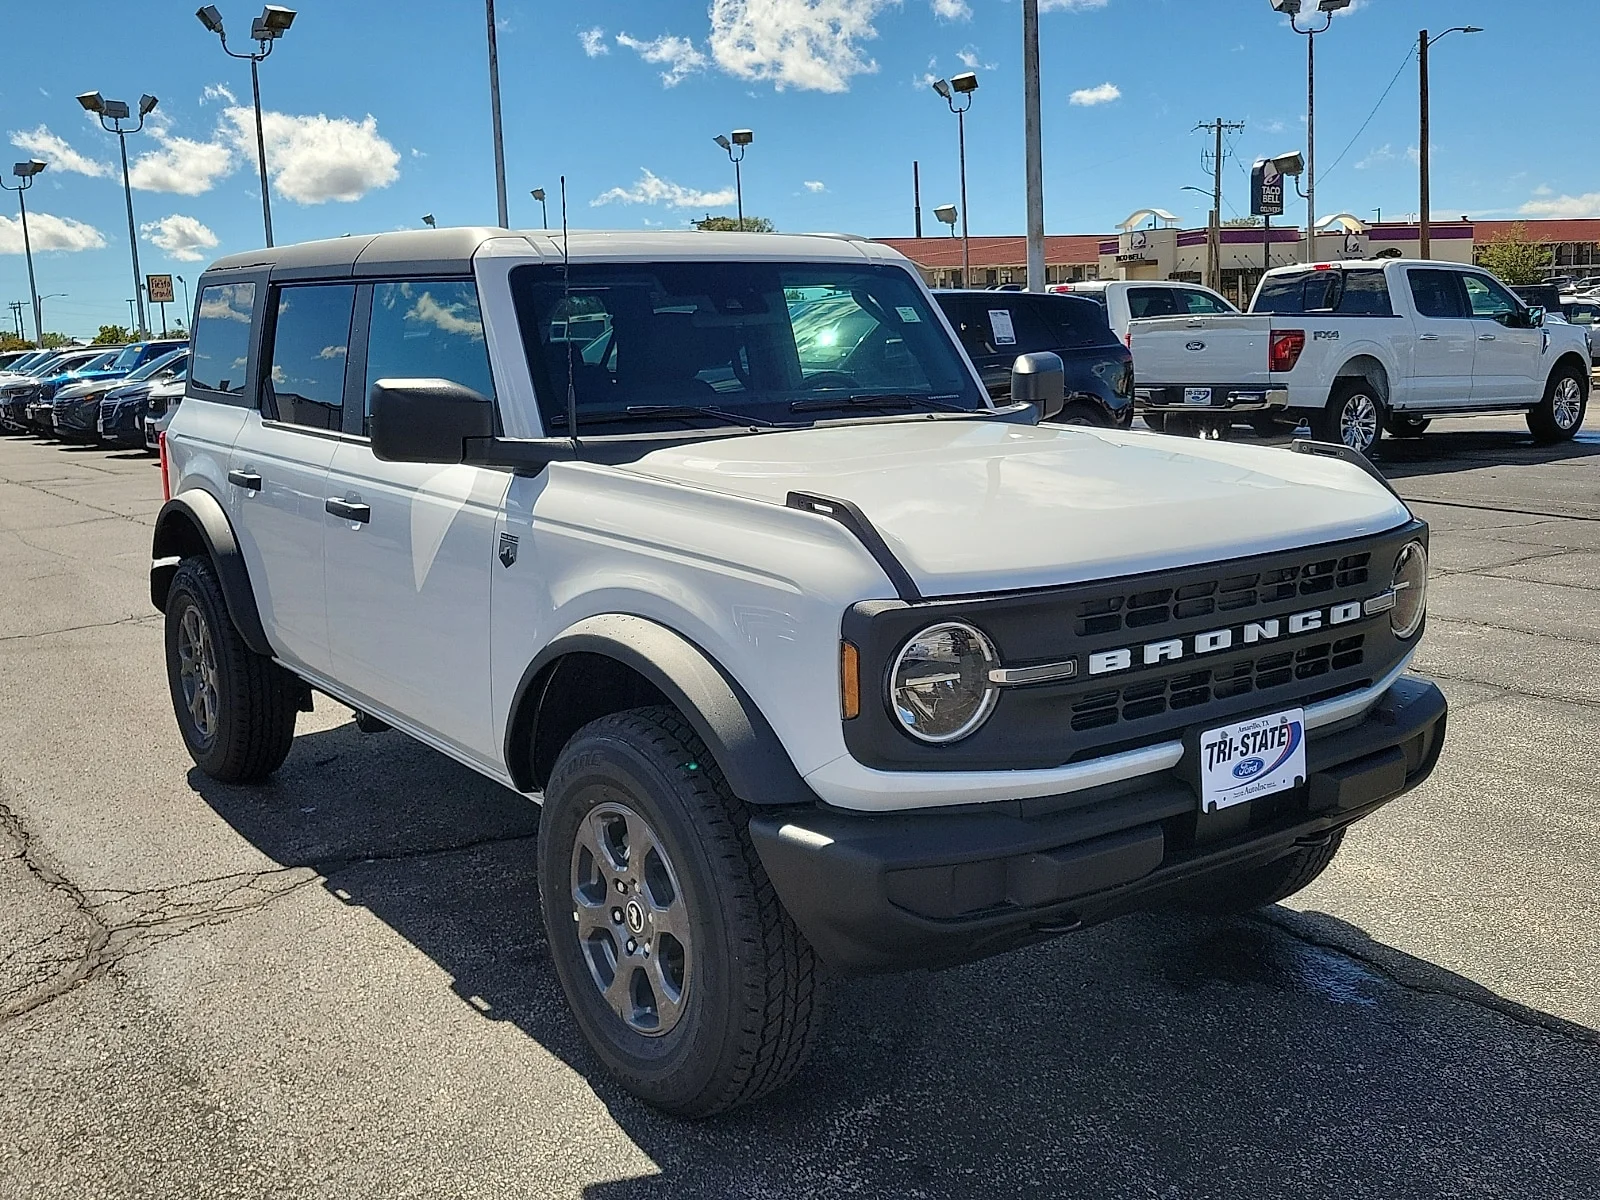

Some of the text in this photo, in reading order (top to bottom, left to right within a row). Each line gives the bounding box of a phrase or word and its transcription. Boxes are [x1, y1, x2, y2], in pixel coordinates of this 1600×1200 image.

[1261, 186, 1281, 195] TACO
[1262, 194, 1280, 203] BELL
[1313, 330, 1340, 341] FX4
[1088, 601, 1361, 675] BRONCO
[1204, 725, 1289, 773] TRI-STATE
[1238, 760, 1259, 776] Ford
